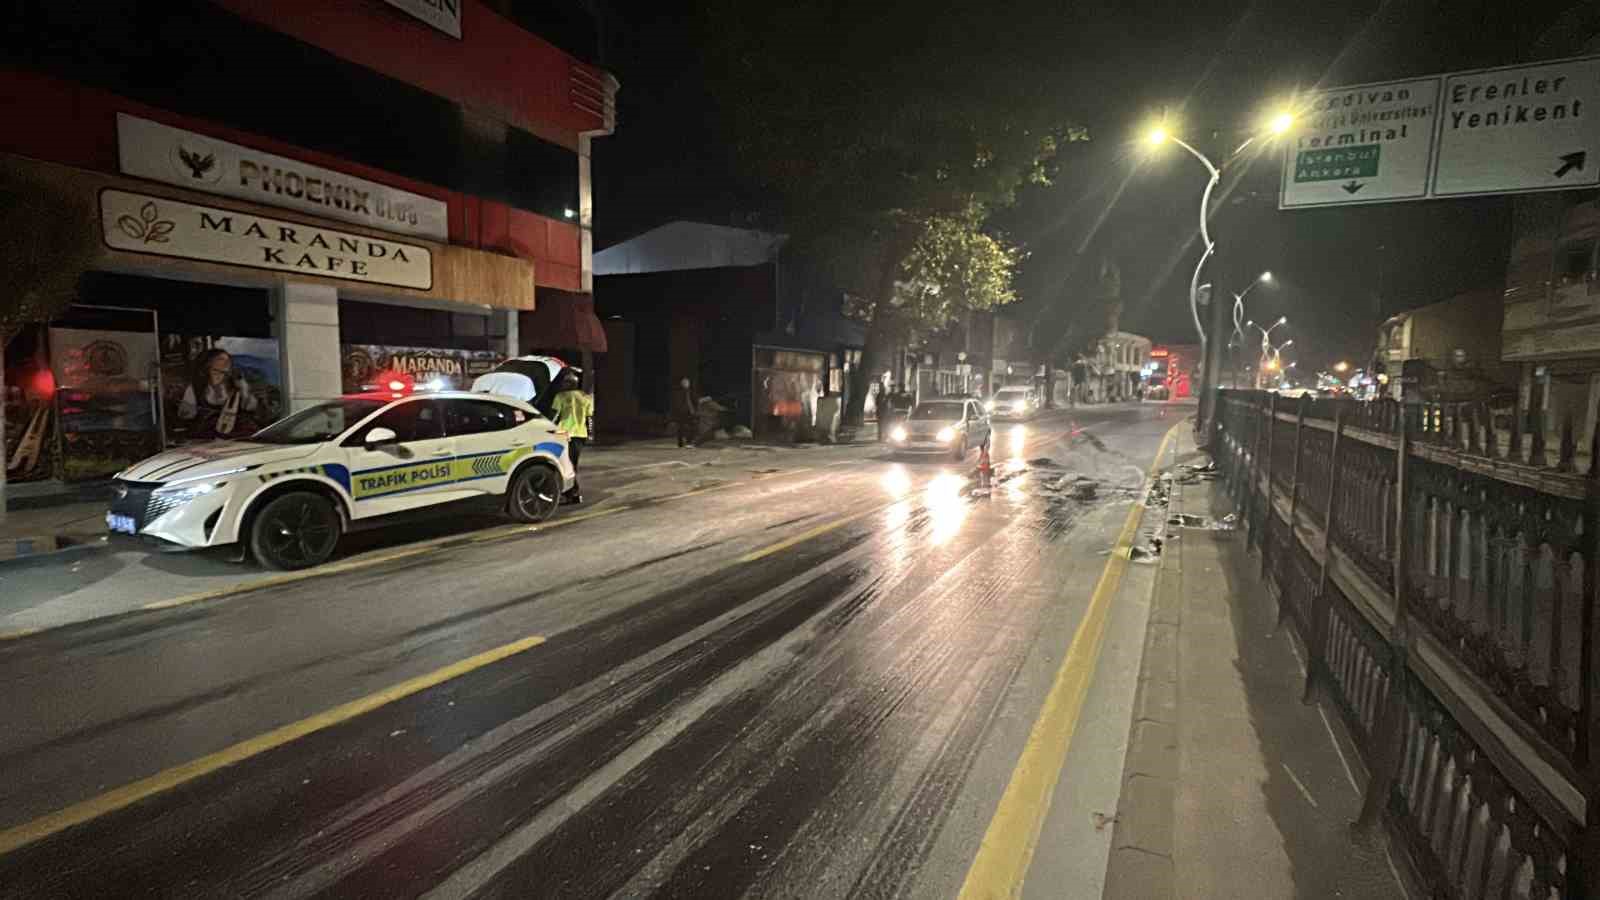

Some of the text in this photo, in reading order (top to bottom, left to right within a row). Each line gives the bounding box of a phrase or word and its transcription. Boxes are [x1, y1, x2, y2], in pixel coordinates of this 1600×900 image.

[1452, 75, 1567, 103] Erenler
[1452, 99, 1582, 129] Yenikent
[239, 160, 370, 216] PHOENIX
[200, 213, 409, 263] MARANDA
[264, 247, 369, 276] KAFE
[392, 356, 461, 375] MARANDA
[360, 464, 450, 490] TRAFİK POLİSİ
